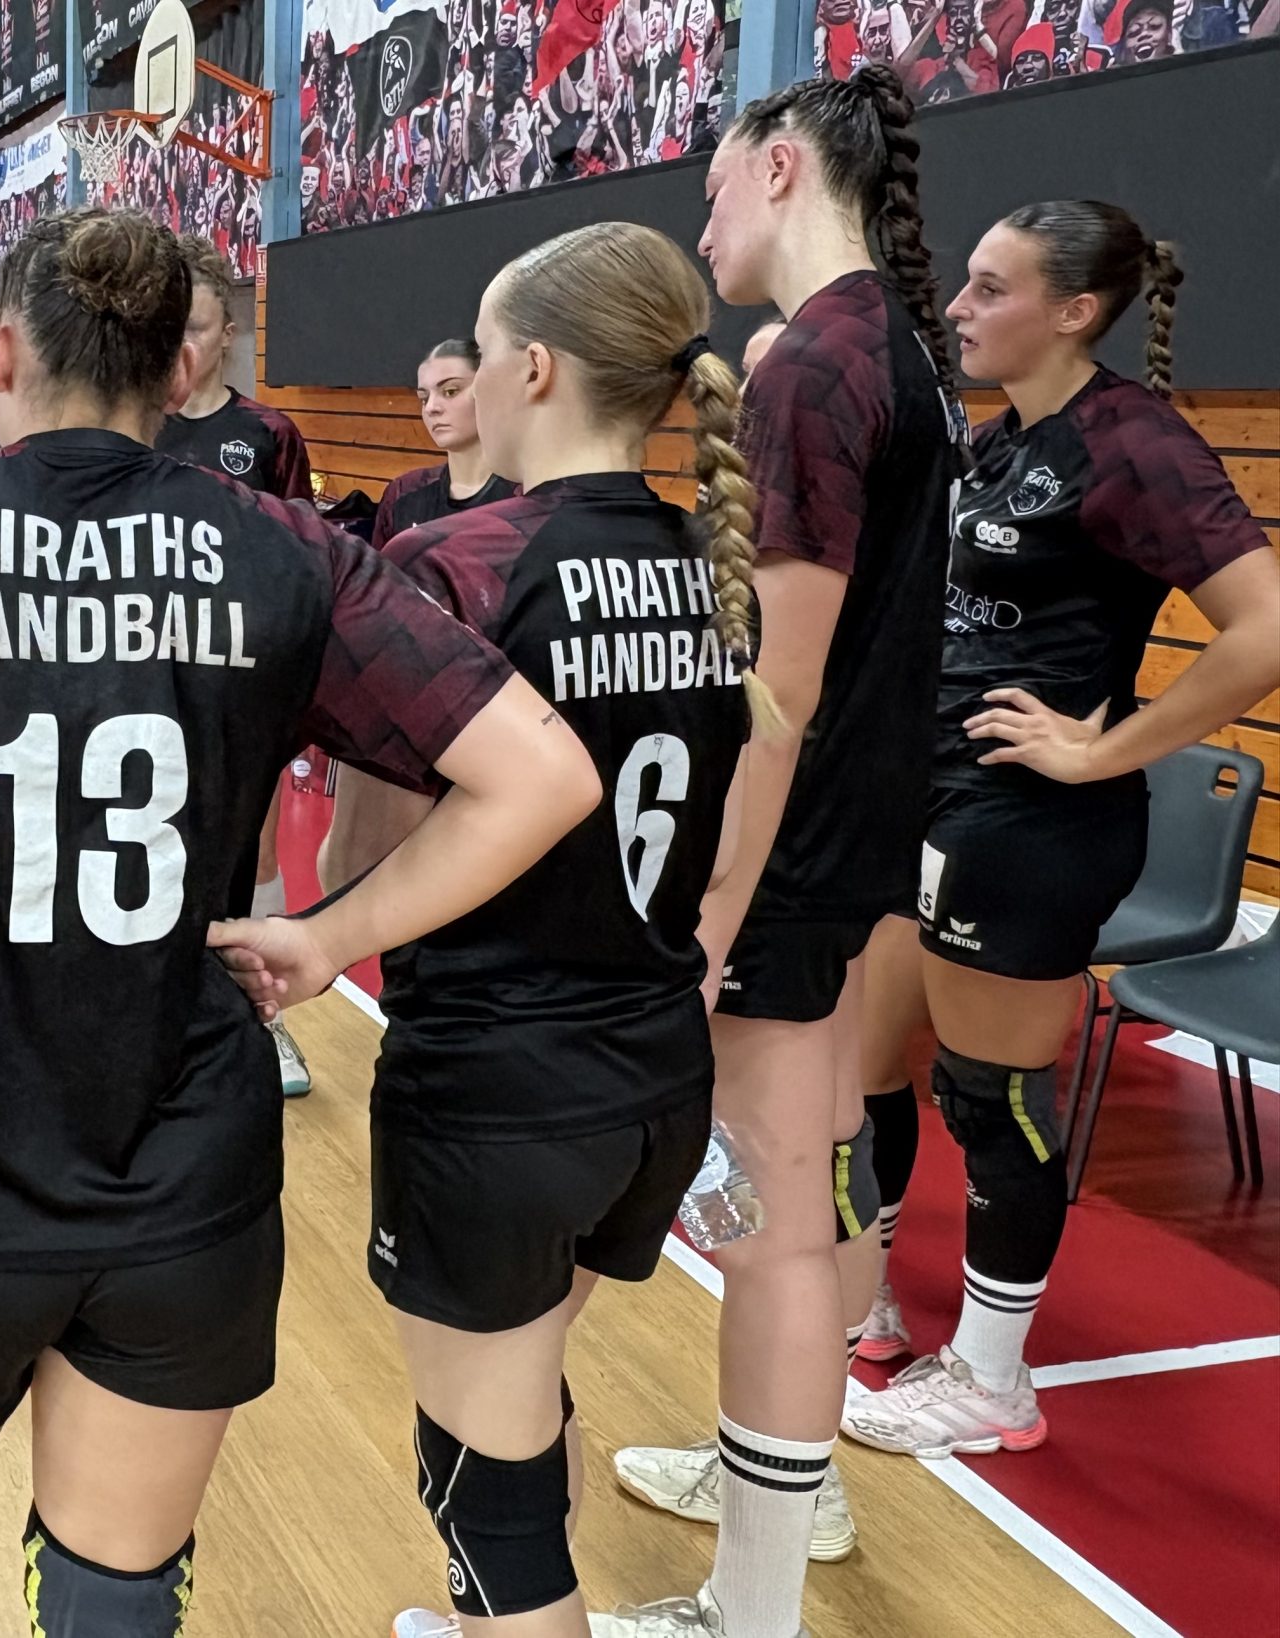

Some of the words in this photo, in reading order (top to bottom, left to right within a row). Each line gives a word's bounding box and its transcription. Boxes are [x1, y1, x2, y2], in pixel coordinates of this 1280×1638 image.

[557, 557, 724, 622] PIRATH
[550, 629, 751, 702] HANDBAL
[615, 733, 690, 923] 6
[939, 930, 982, 951] erima
